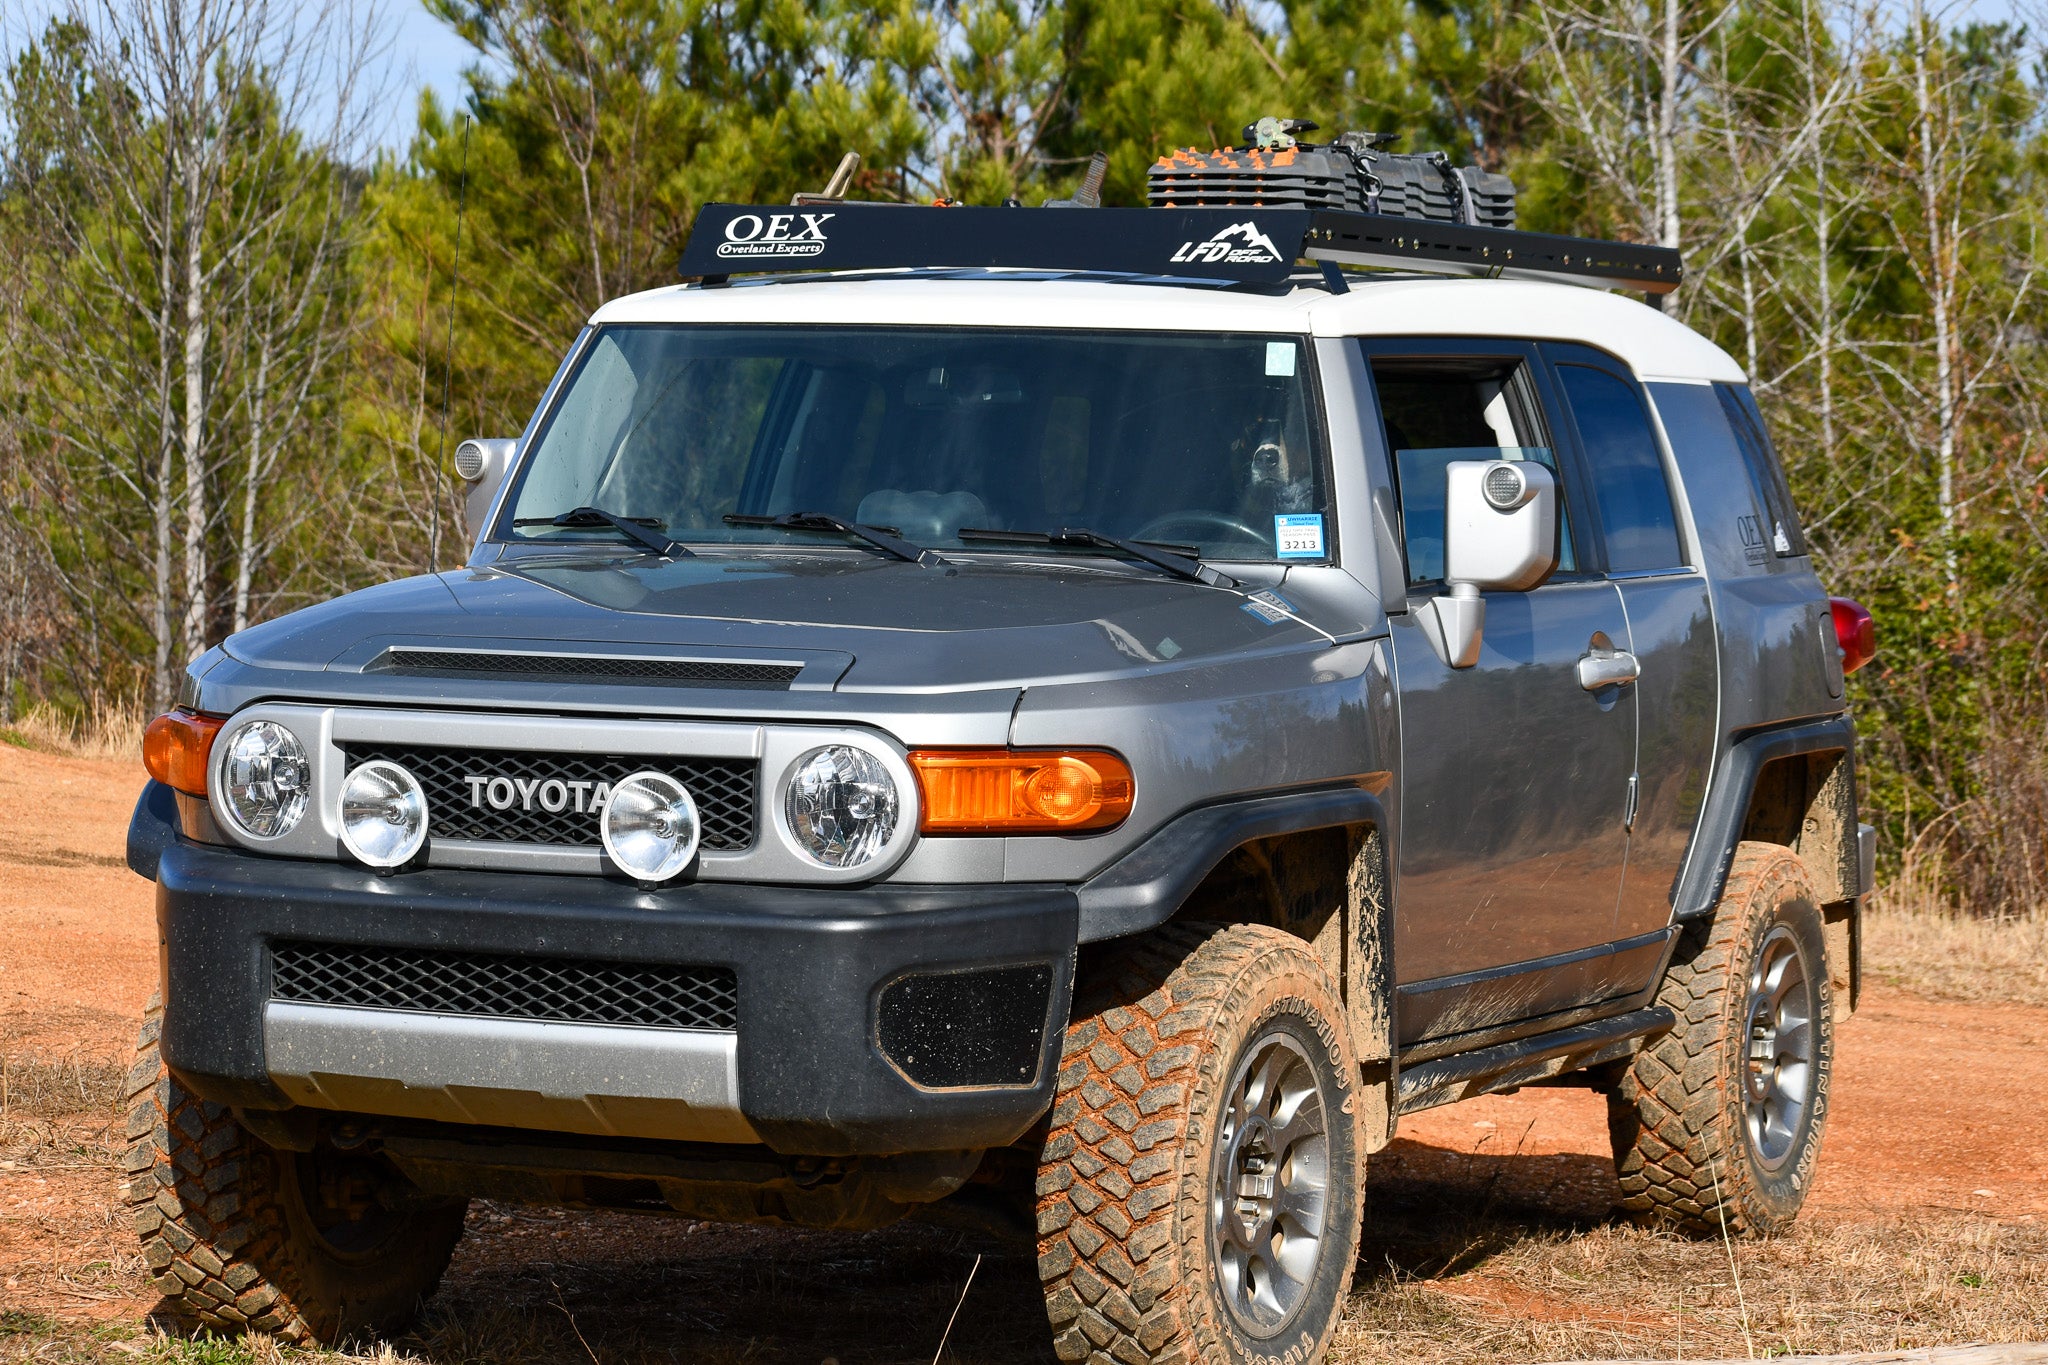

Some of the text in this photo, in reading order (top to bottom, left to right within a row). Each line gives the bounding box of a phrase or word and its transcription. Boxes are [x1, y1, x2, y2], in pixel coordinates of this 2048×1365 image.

[725, 213, 835, 242] OEX
[720, 243, 821, 255] Overland Experts
[1169, 241, 1232, 262] LFD
[1223, 255, 1274, 263] ROAD
[1284, 540, 1316, 549] 3213
[464, 775, 612, 813] TOYOTA
[1797, 979, 1831, 1180] DESTINATION
